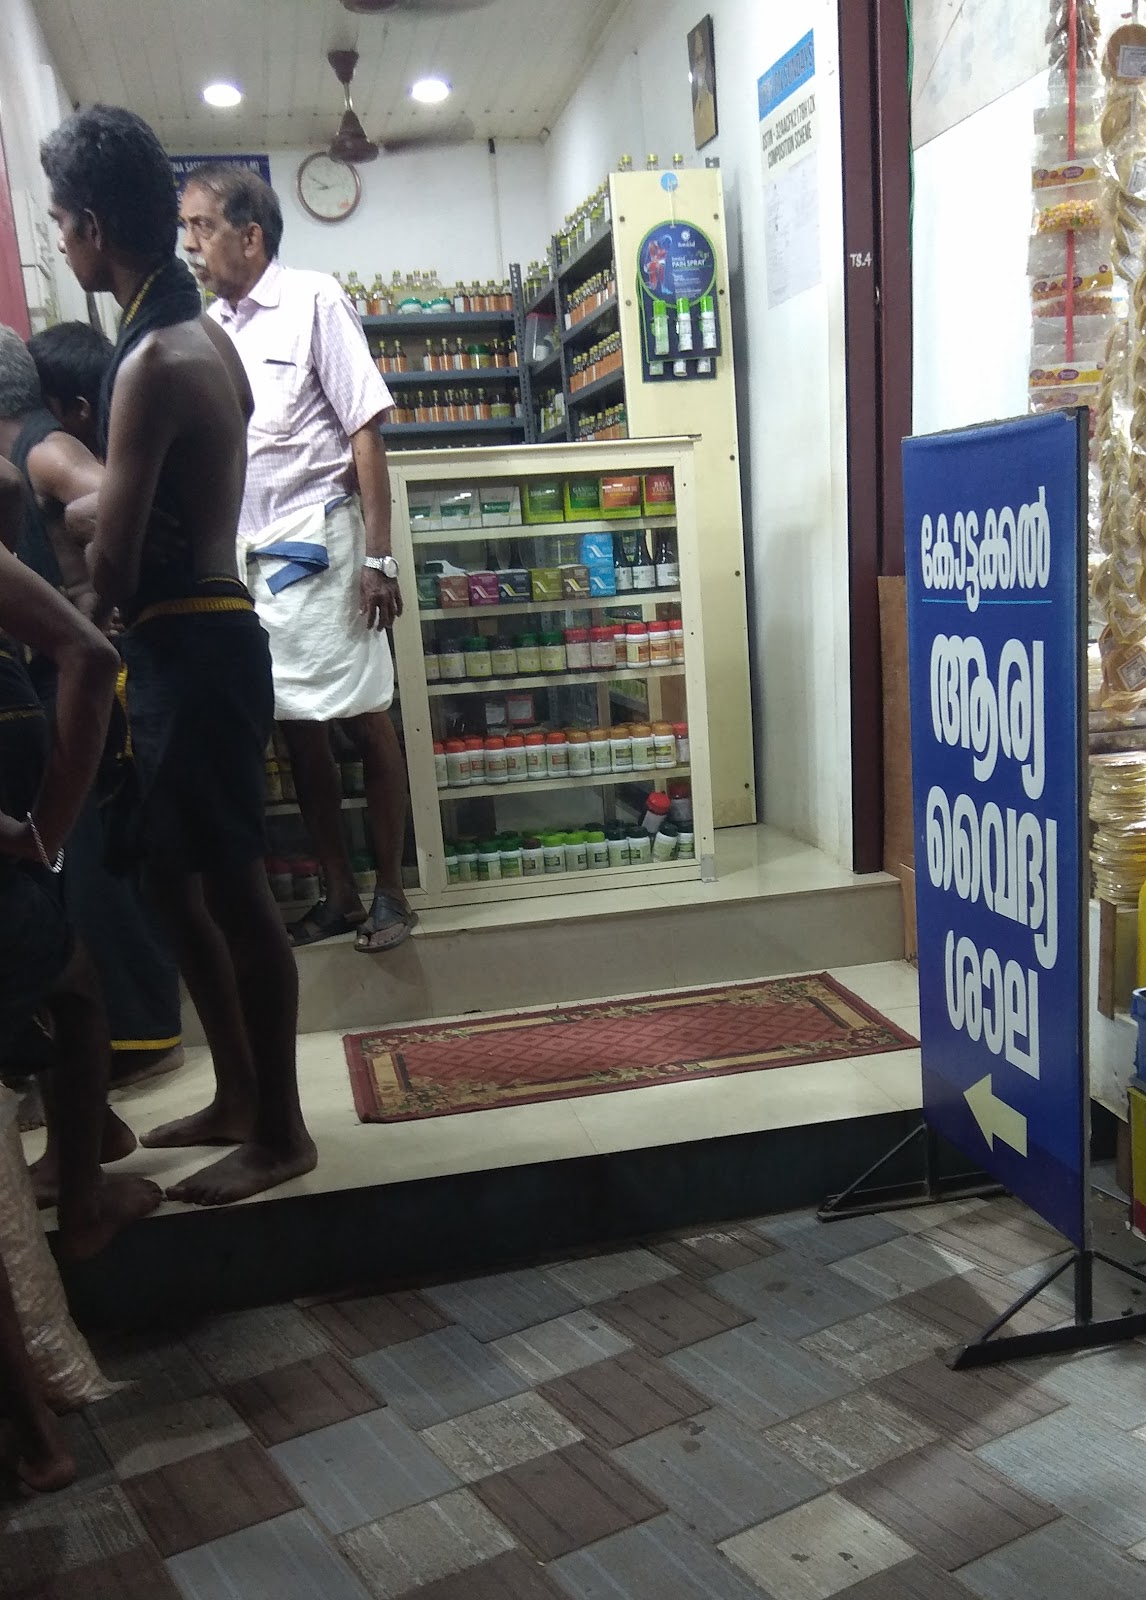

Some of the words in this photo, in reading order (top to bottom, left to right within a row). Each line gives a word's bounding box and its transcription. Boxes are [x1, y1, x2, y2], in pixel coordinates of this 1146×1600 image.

[767, 137, 795, 169] COMPOSITION
[794, 121, 812, 150] SCHEME
[687, 259, 705, 267] SPRAY
[921, 485, 1051, 612] കോട്ടക്കൽ
[930, 633, 1045, 799] ആര്യ
[926, 785, 1058, 969] വൈദ്യ
[944, 929, 1040, 1080] ശാല
